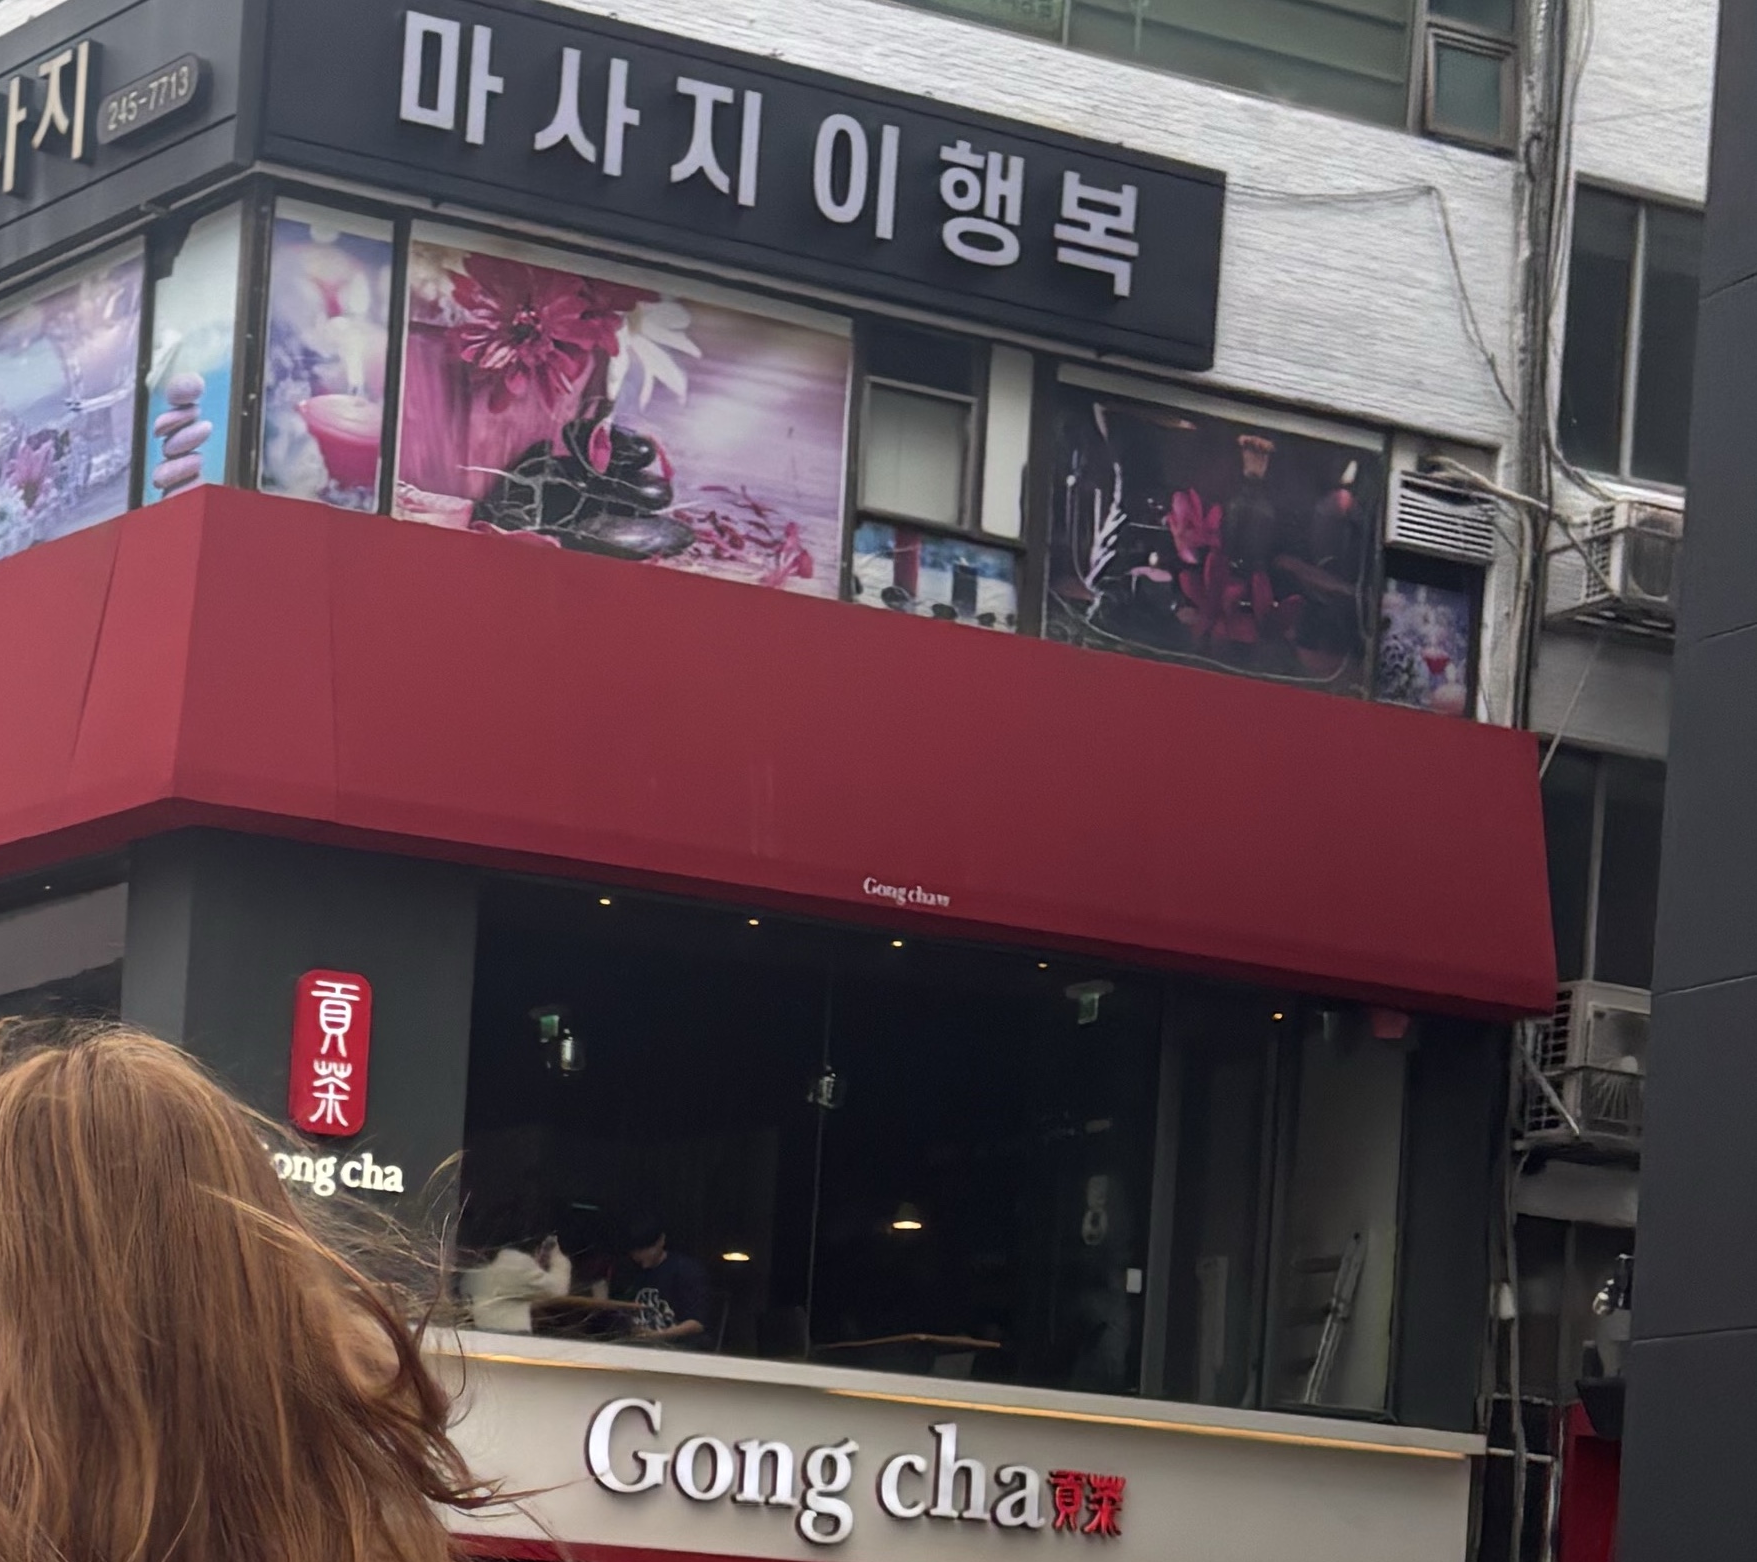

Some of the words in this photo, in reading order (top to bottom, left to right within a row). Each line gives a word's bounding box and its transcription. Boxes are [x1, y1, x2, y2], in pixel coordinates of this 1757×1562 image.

[107, 66, 189, 131] 245-7713
[399, 11, 763, 207] 마사지
[812, 113, 1140, 298] 이행복
[310, 981, 361, 1127] 貢茶
[263, 1143, 337, 1196] ong
[341, 1153, 404, 1193] cha
[587, 1398, 858, 1544] Gong
[878, 1423, 1044, 1529] cha
